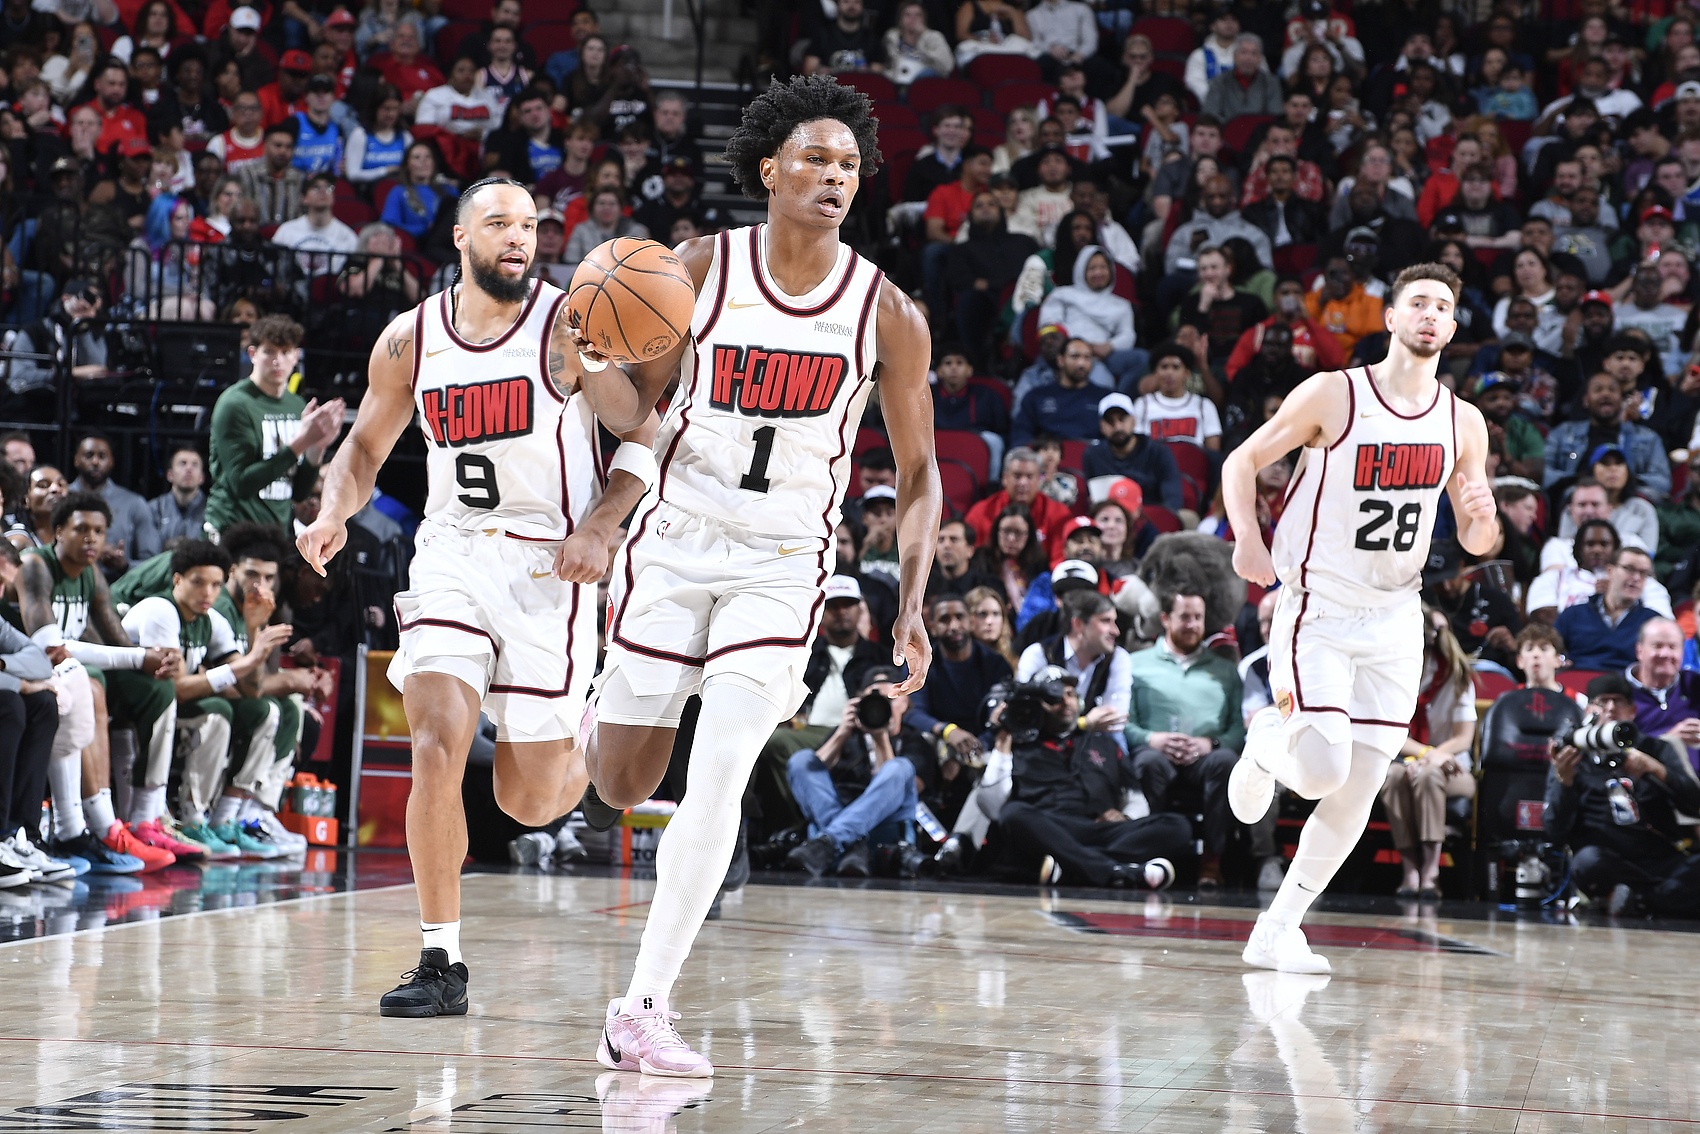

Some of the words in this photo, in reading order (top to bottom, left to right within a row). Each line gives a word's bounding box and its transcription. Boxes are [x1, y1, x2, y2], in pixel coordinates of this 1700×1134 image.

[387, 338, 411, 361] W
[455, 453, 500, 510] 9
[740, 426, 776, 493] 1
[1355, 499, 1422, 552] 28
